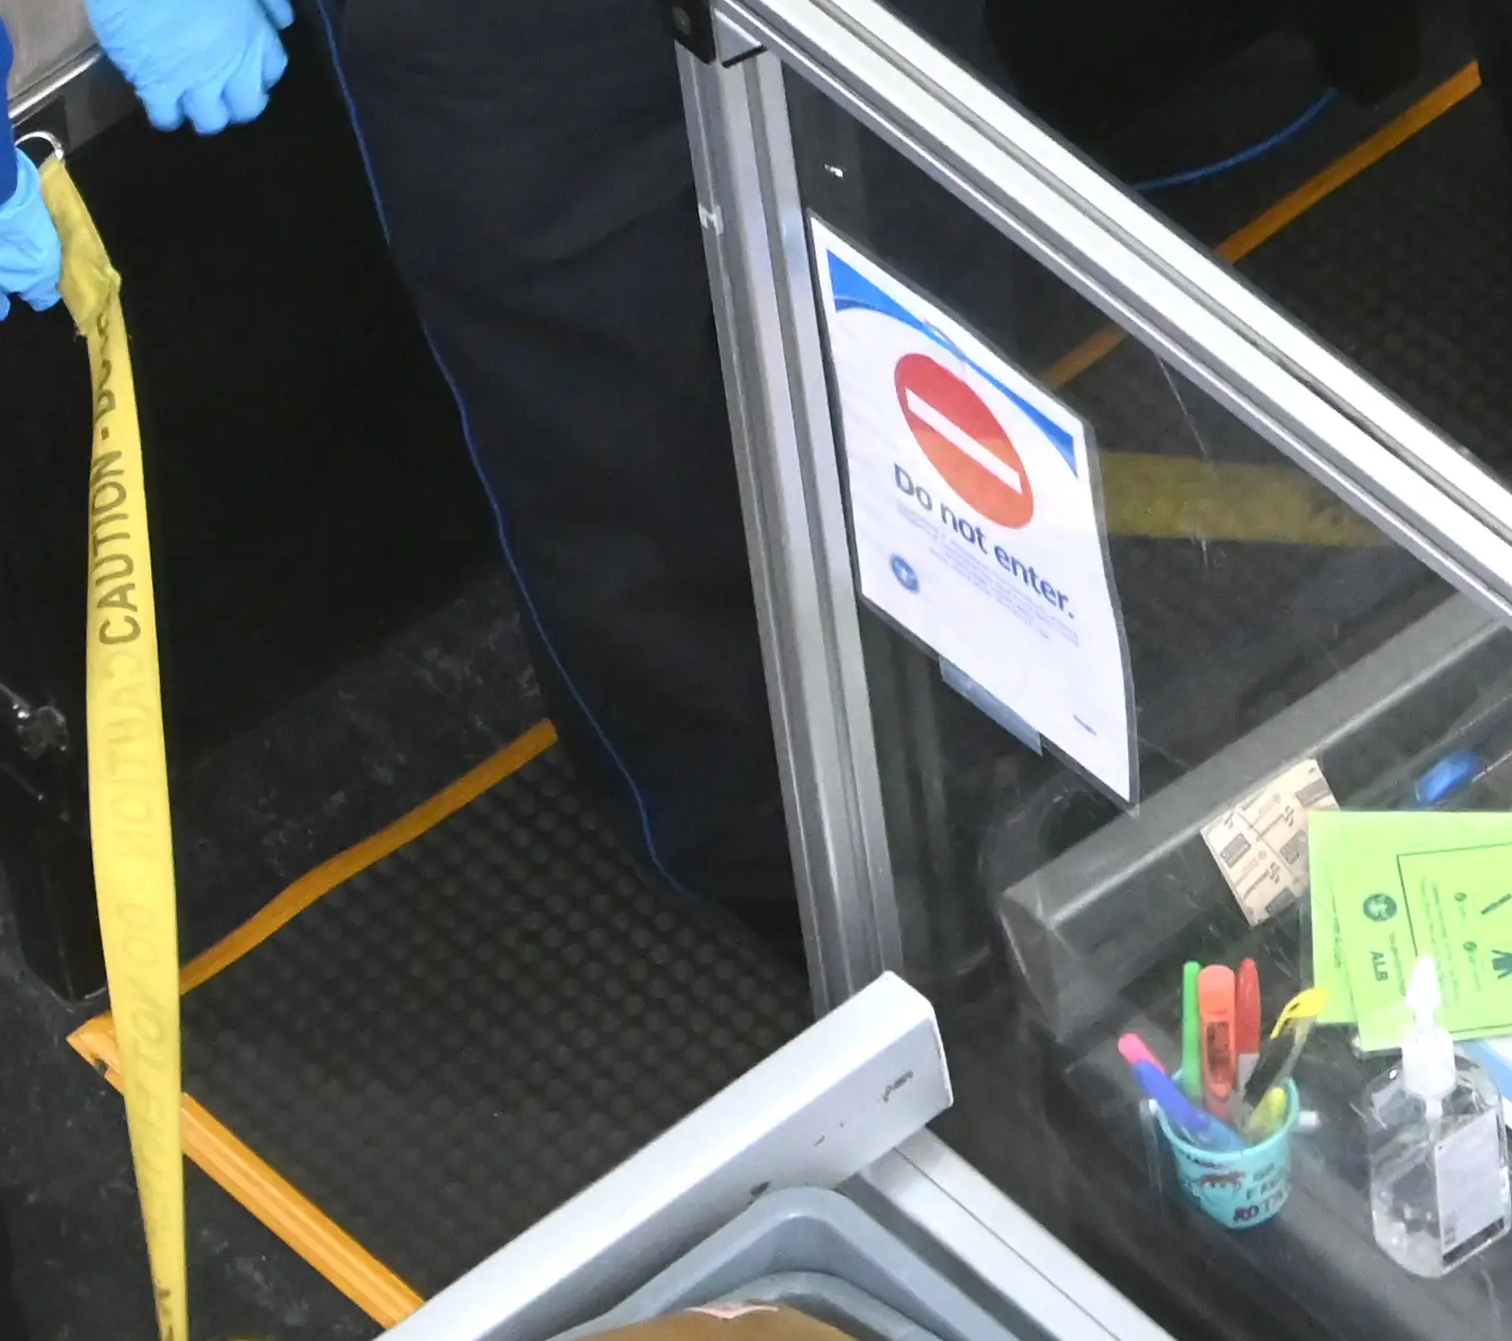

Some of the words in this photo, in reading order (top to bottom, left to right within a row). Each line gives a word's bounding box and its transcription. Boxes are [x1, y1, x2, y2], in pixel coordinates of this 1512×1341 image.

[91, 449, 141, 647] CAUTION
[893, 461, 933, 512] Do
[939, 499, 989, 556] not
[993, 541, 1075, 620] enter.
[1369, 950, 1388, 982] ALB
